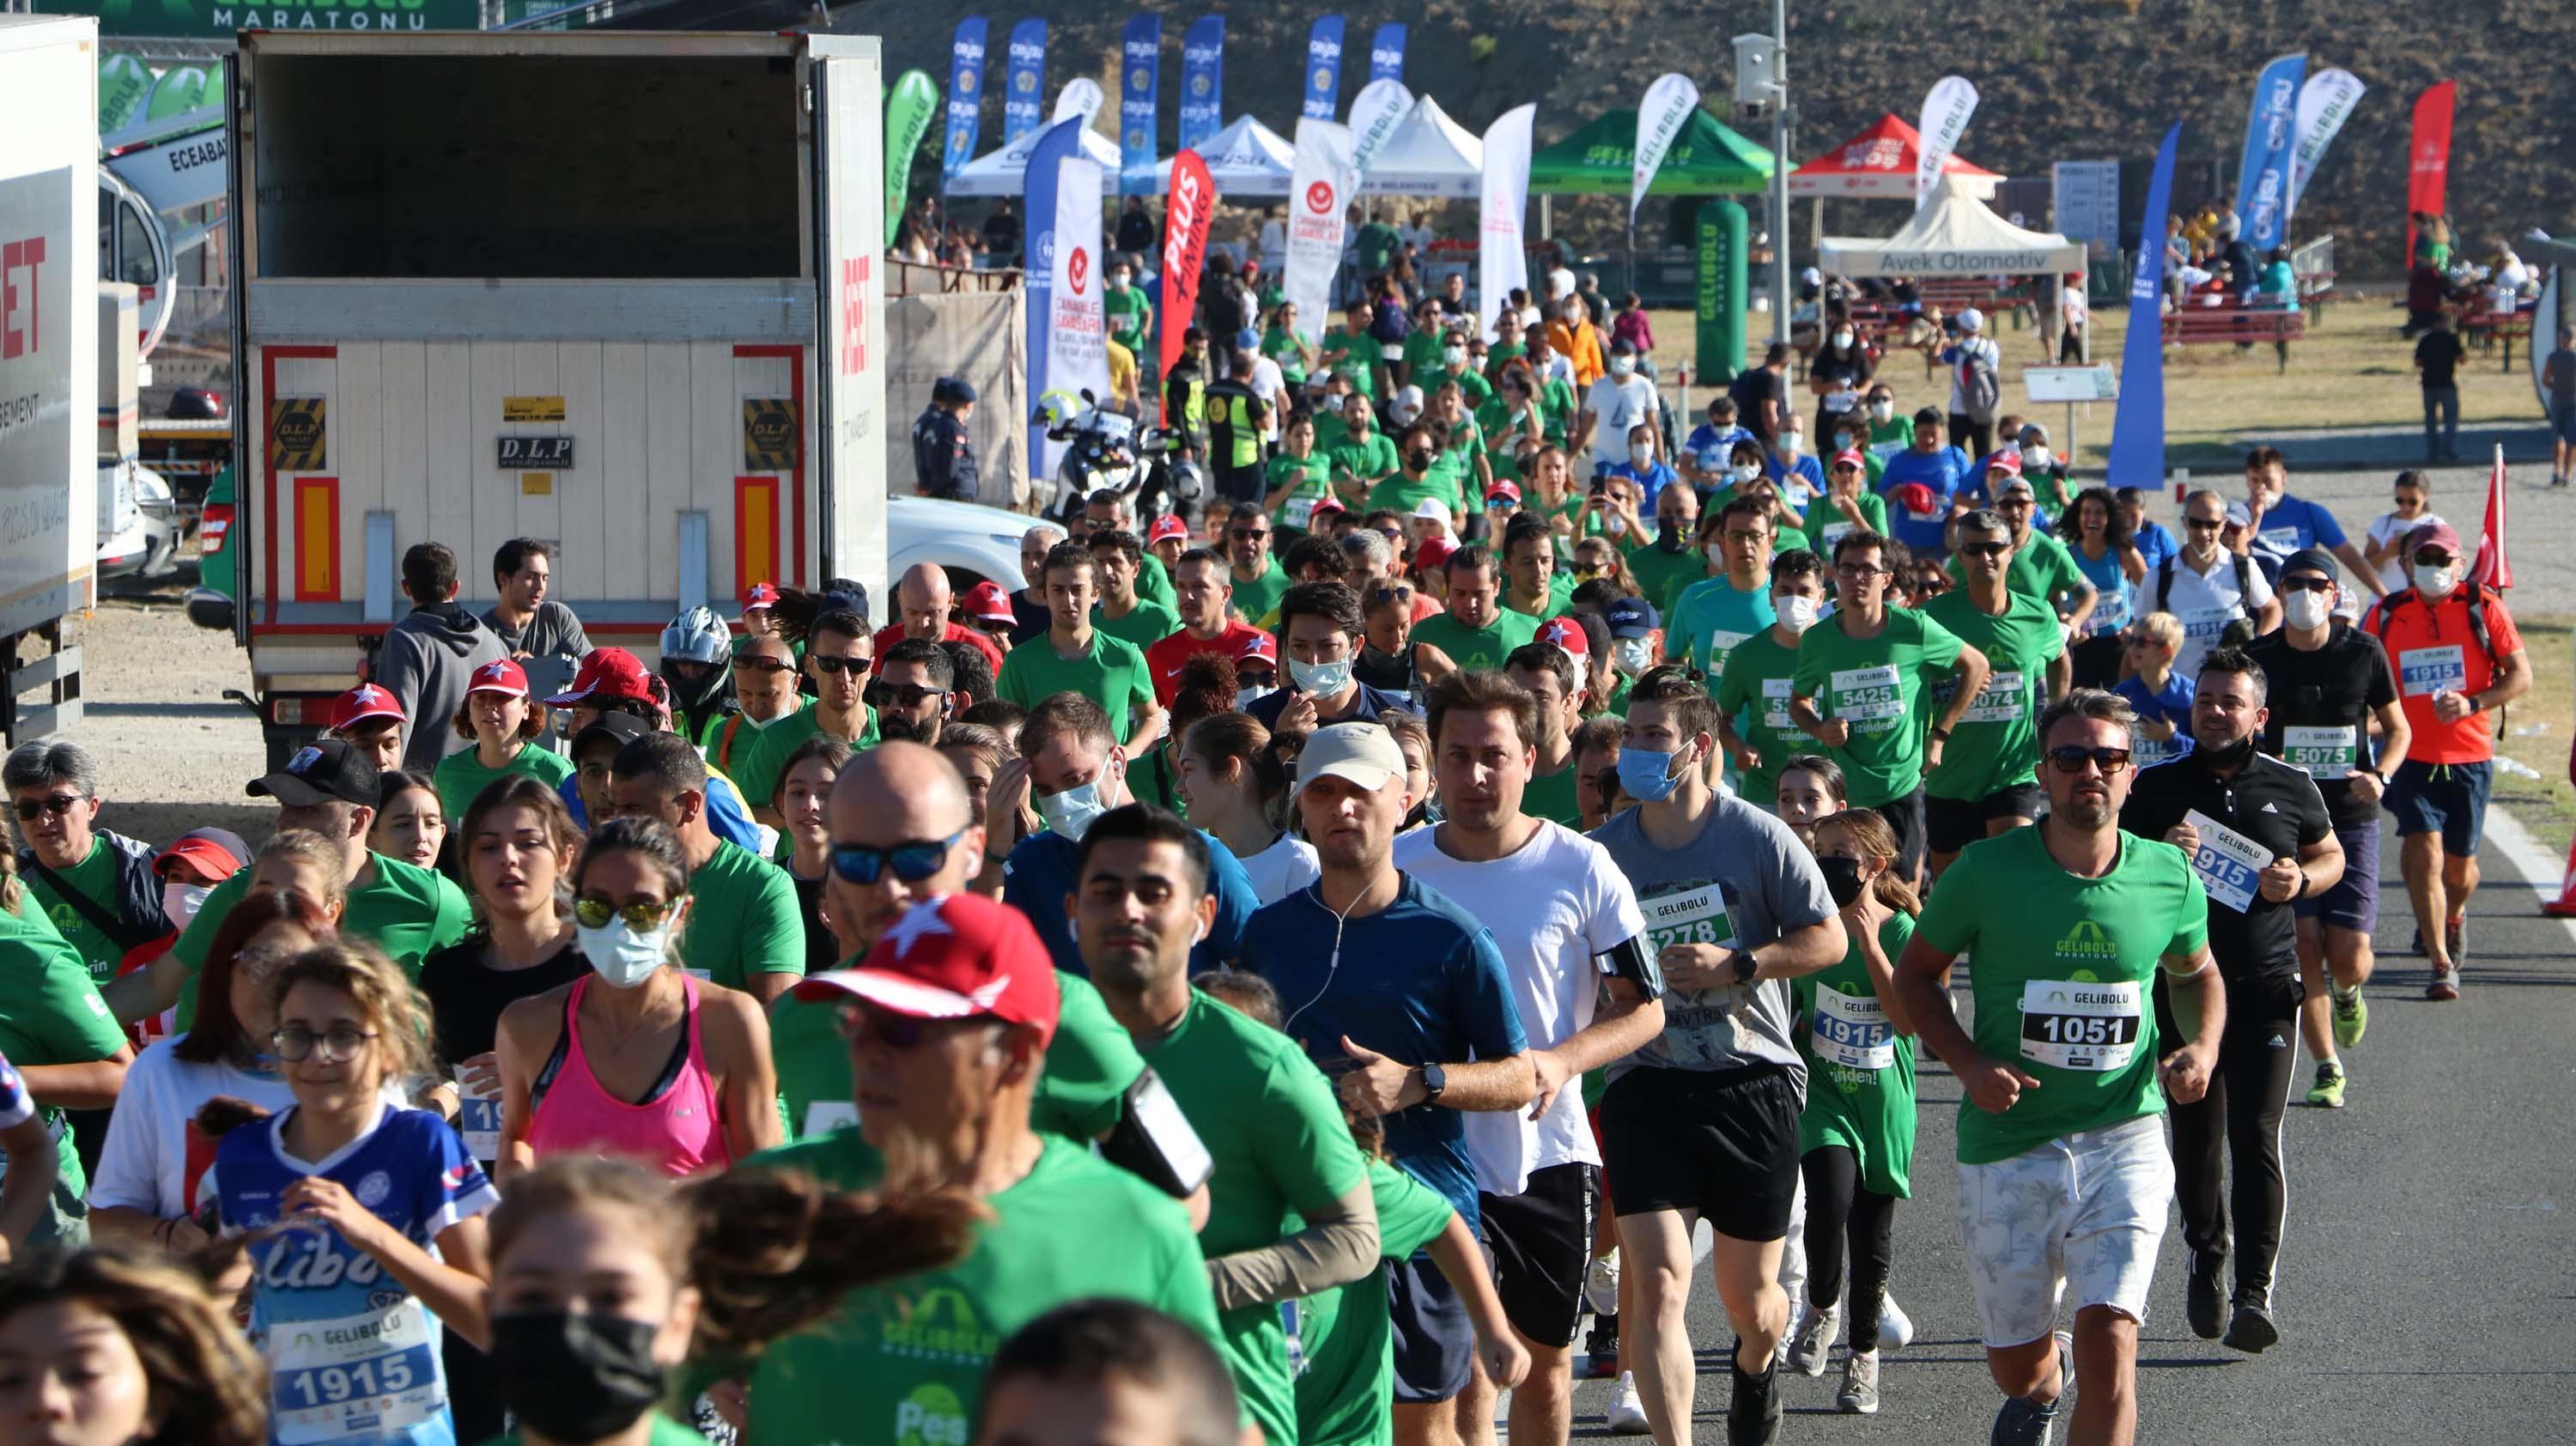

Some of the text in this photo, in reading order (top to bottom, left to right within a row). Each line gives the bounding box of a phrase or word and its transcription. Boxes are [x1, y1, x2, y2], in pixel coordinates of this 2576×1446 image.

[214, 9, 424, 30] MARATONU
[1164, 166, 1200, 274] PLUS
[1881, 250, 2048, 270] Avek Otomotiv
[501, 439, 571, 459] D.L.P
[2410, 665, 2456, 682] 1915
[1843, 686, 1893, 707] 5425
[2295, 748, 2347, 763] 5075
[2196, 848, 2249, 887] 915
[1844, 1002, 1882, 1012] GELIBOL
[1823, 1016, 1883, 1047] 1915
[2043, 1016, 2123, 1044] 1051
[293, 1352, 413, 1406] 1915
